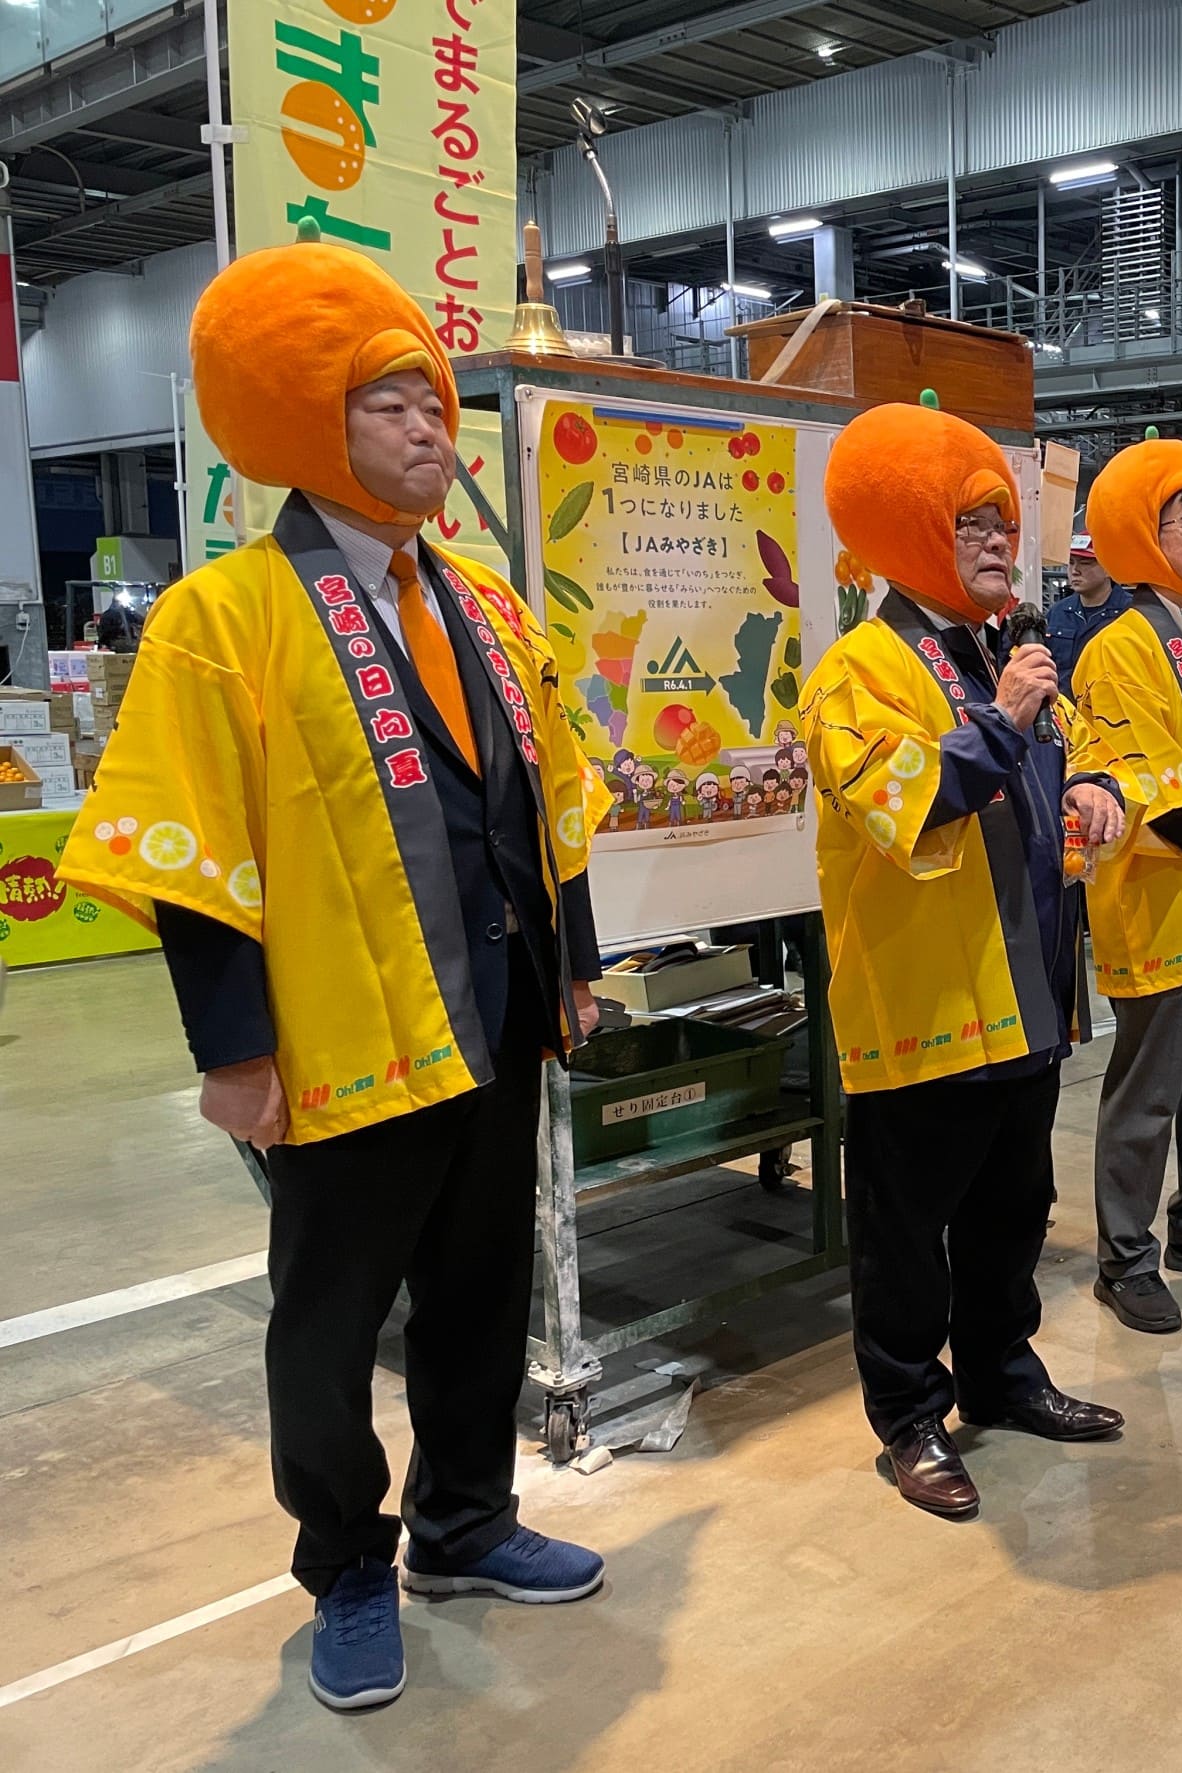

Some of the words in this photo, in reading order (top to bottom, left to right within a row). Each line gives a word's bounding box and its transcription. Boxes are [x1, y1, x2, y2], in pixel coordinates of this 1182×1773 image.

[611, 462, 733, 490] 宮崎県のJAは
[602, 487, 743, 522] 1つになりました
[622, 532, 727, 558] 【JAみやざき】
[103, 555, 117, 575] B1
[314, 574, 428, 789] 宮崎の日向夏
[442, 568, 539, 766] 宮崎のきんかん
[663, 679, 693, 691] R6.4.1
[613, 1087, 696, 1118] せり固定台①
